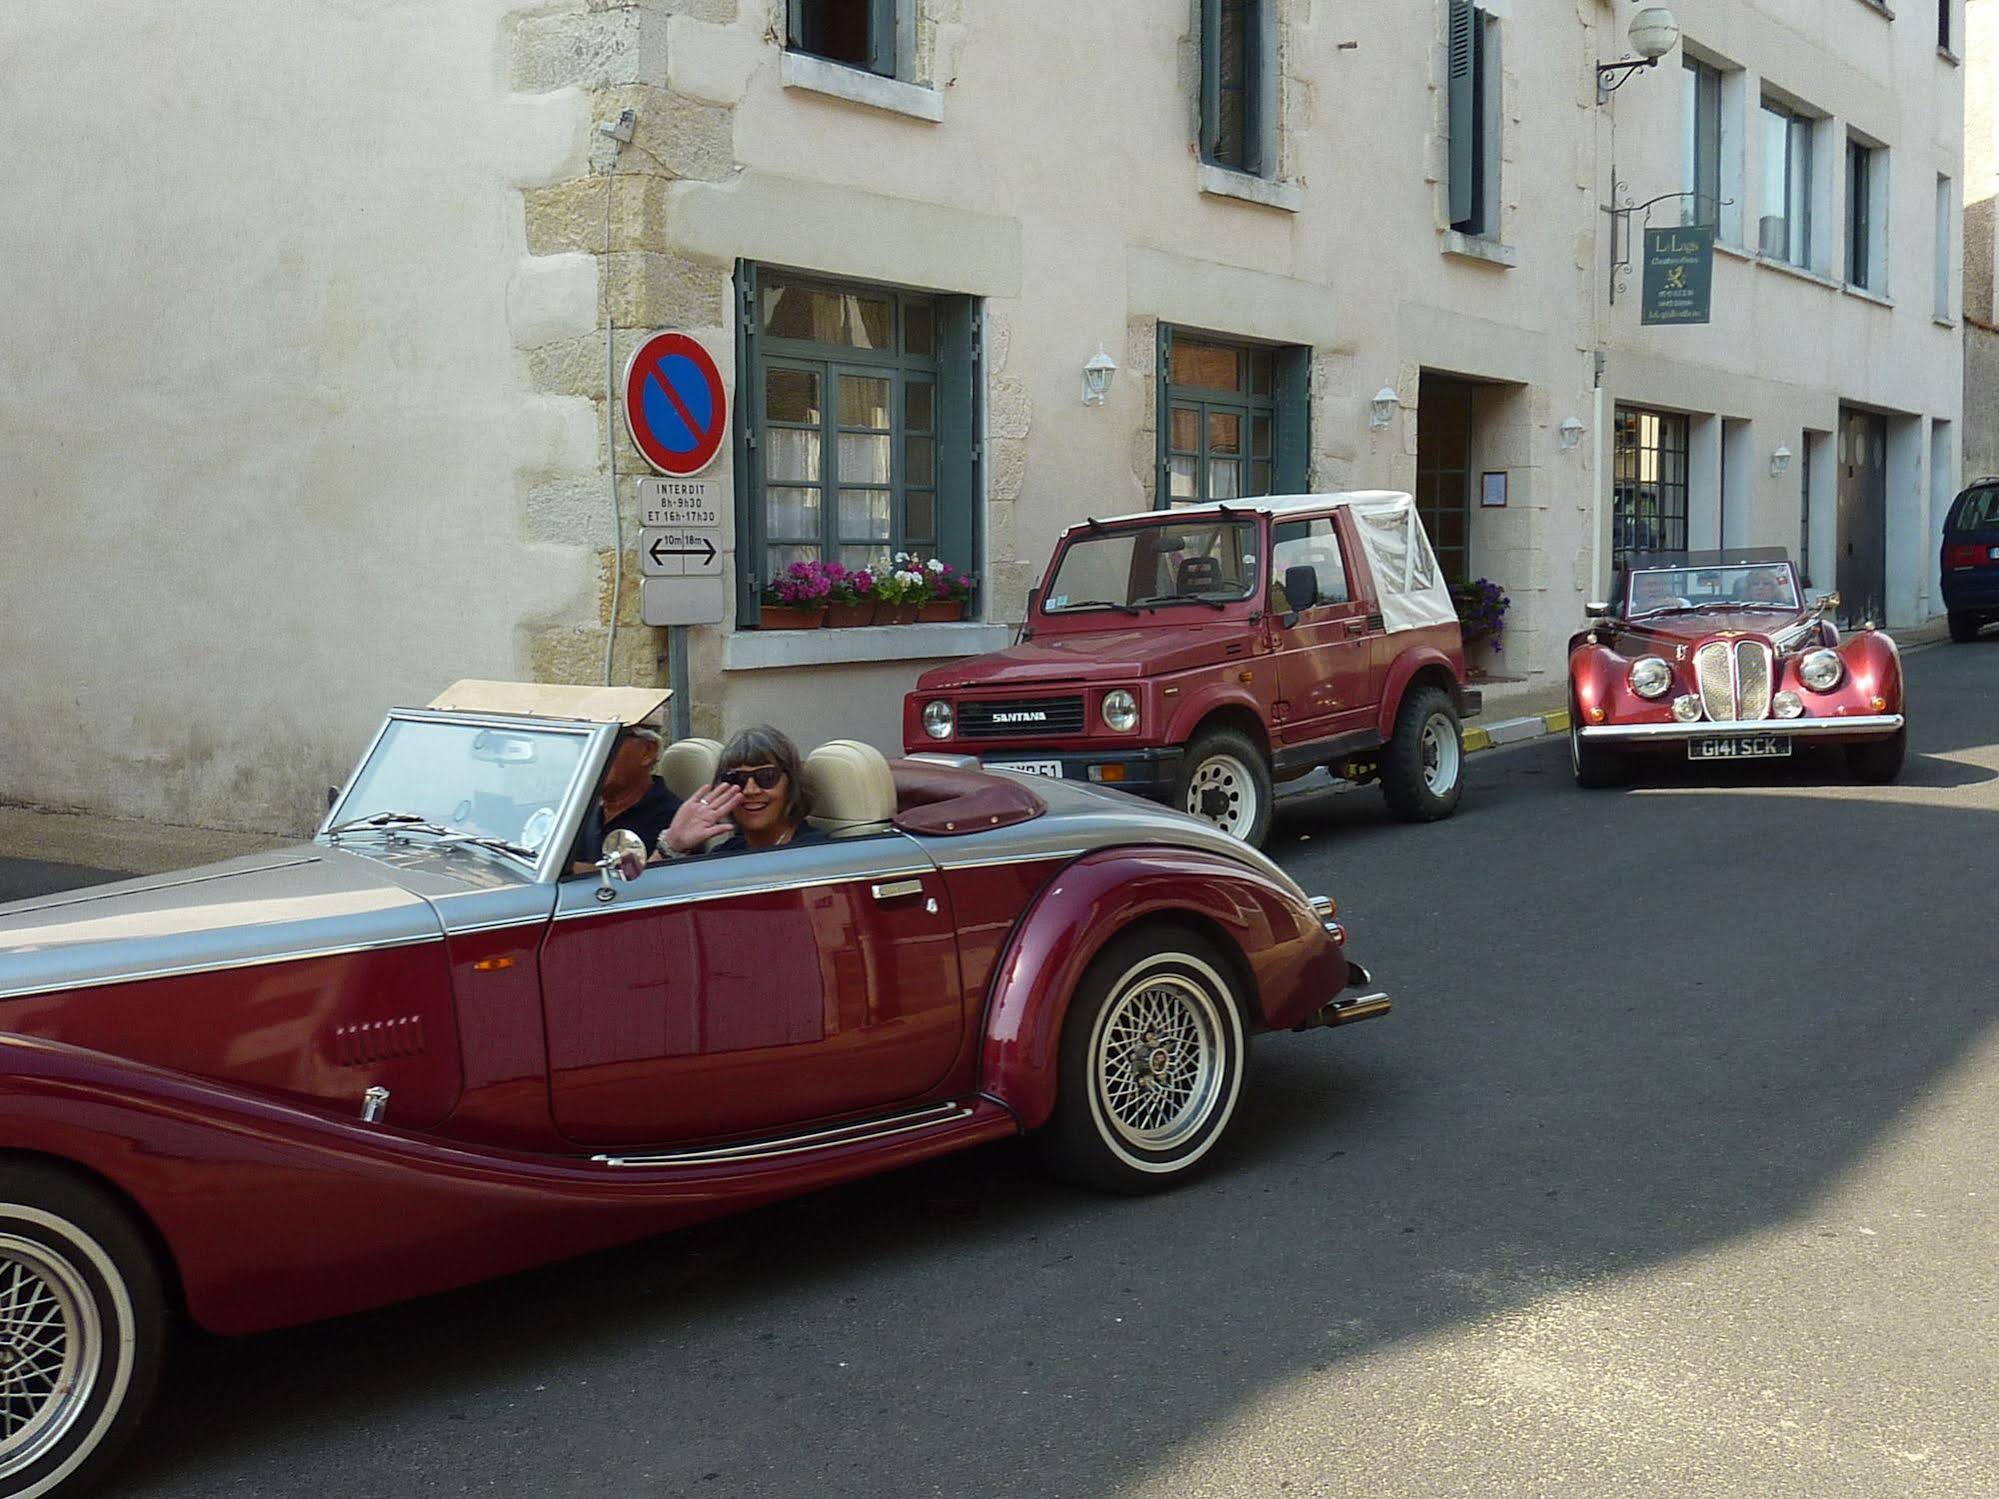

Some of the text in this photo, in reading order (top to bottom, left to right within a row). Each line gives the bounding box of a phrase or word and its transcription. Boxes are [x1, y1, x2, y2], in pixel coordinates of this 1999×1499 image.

[656, 484, 705, 495] INTERDIT
[661, 498, 702, 508] 8h-9h30
[648, 511, 715, 521] ET 16h-17h30
[664, 535, 702, 545] 10m 18m
[992, 712, 1047, 723] SANTANA
[1702, 737, 1777, 756] G141 SCK
